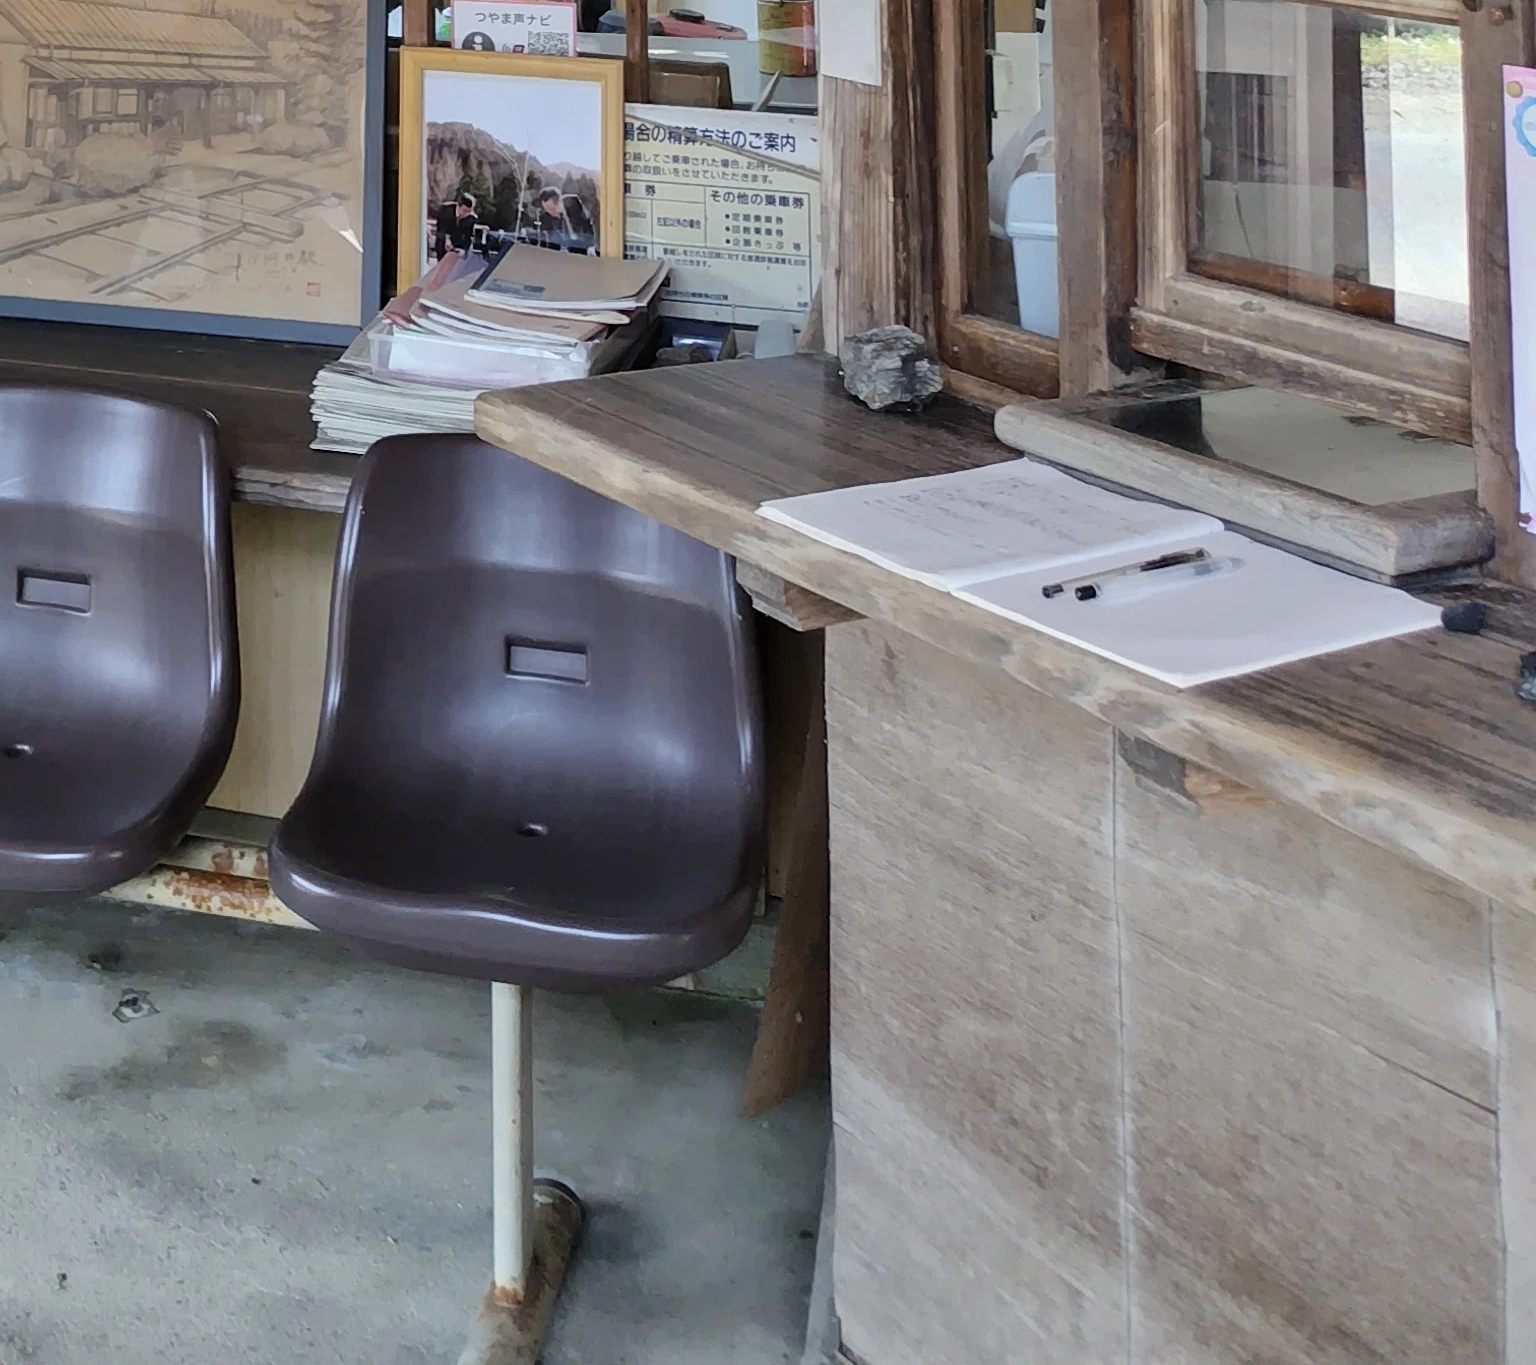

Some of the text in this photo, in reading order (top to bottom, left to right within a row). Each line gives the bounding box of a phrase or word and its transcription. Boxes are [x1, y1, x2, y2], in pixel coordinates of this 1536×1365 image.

[474, 12, 552, 26] つやま声ナビ
[710, 190, 804, 209] その他の乗車券
